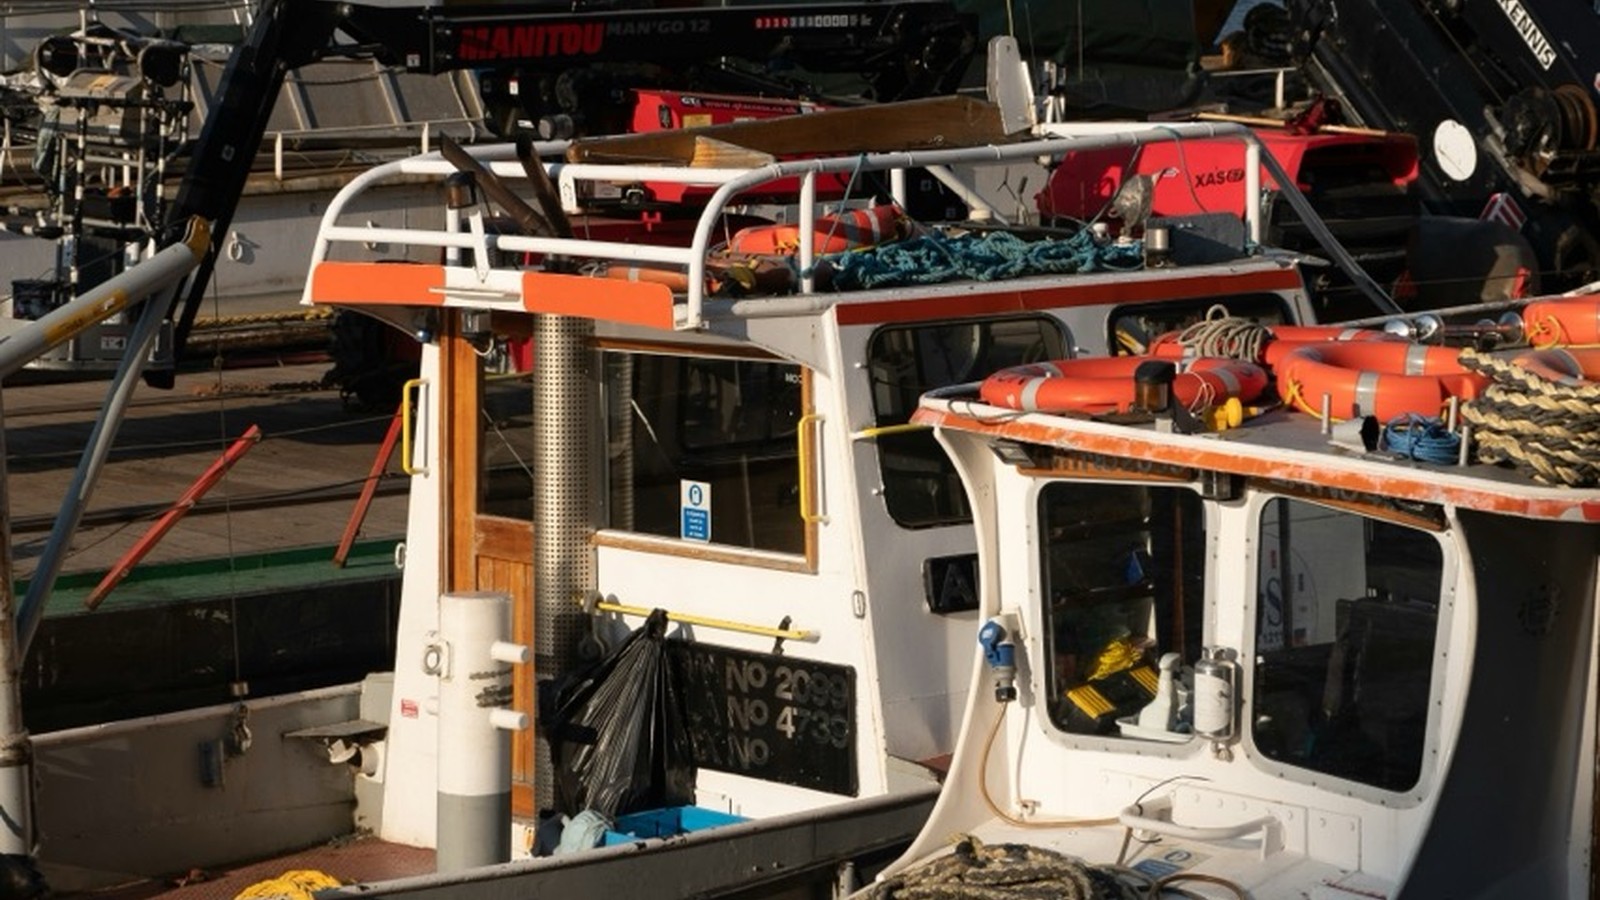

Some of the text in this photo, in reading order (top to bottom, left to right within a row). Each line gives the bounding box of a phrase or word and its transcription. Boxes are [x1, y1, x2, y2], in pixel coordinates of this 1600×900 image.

[458, 17, 712, 60] MANITOU MAN'GO 12
[1195, 171, 1225, 189] XAS
[727, 657, 768, 694] NO
[727, 695, 769, 732] NO
[727, 732, 769, 771] NO
